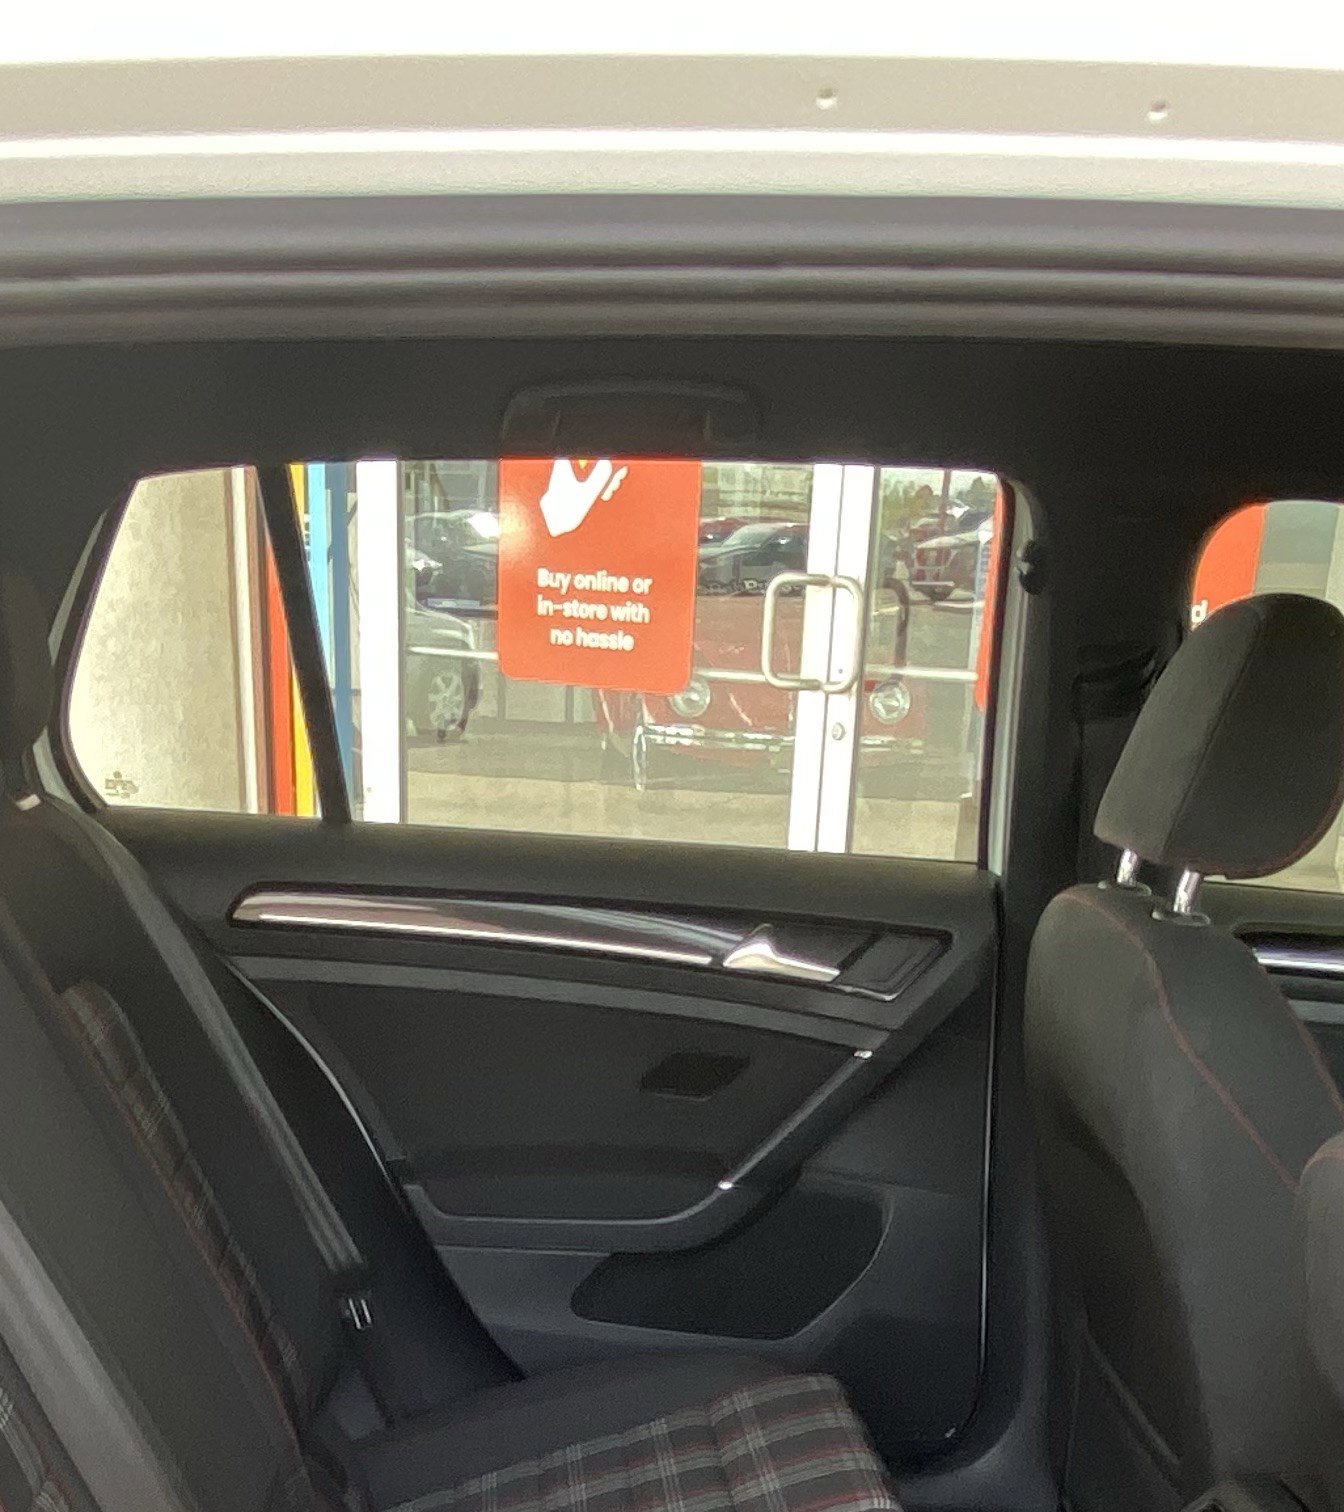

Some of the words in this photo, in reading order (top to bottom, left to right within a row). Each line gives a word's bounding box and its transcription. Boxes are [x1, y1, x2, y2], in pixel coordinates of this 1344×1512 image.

[537, 567, 572, 594] Buy
[573, 570, 628, 593] online
[632, 576, 653, 594] or
[537, 594, 607, 620] in-store
[611, 601, 651, 624] with
[550, 627, 574, 646] no
[575, 627, 635, 651] hassle
